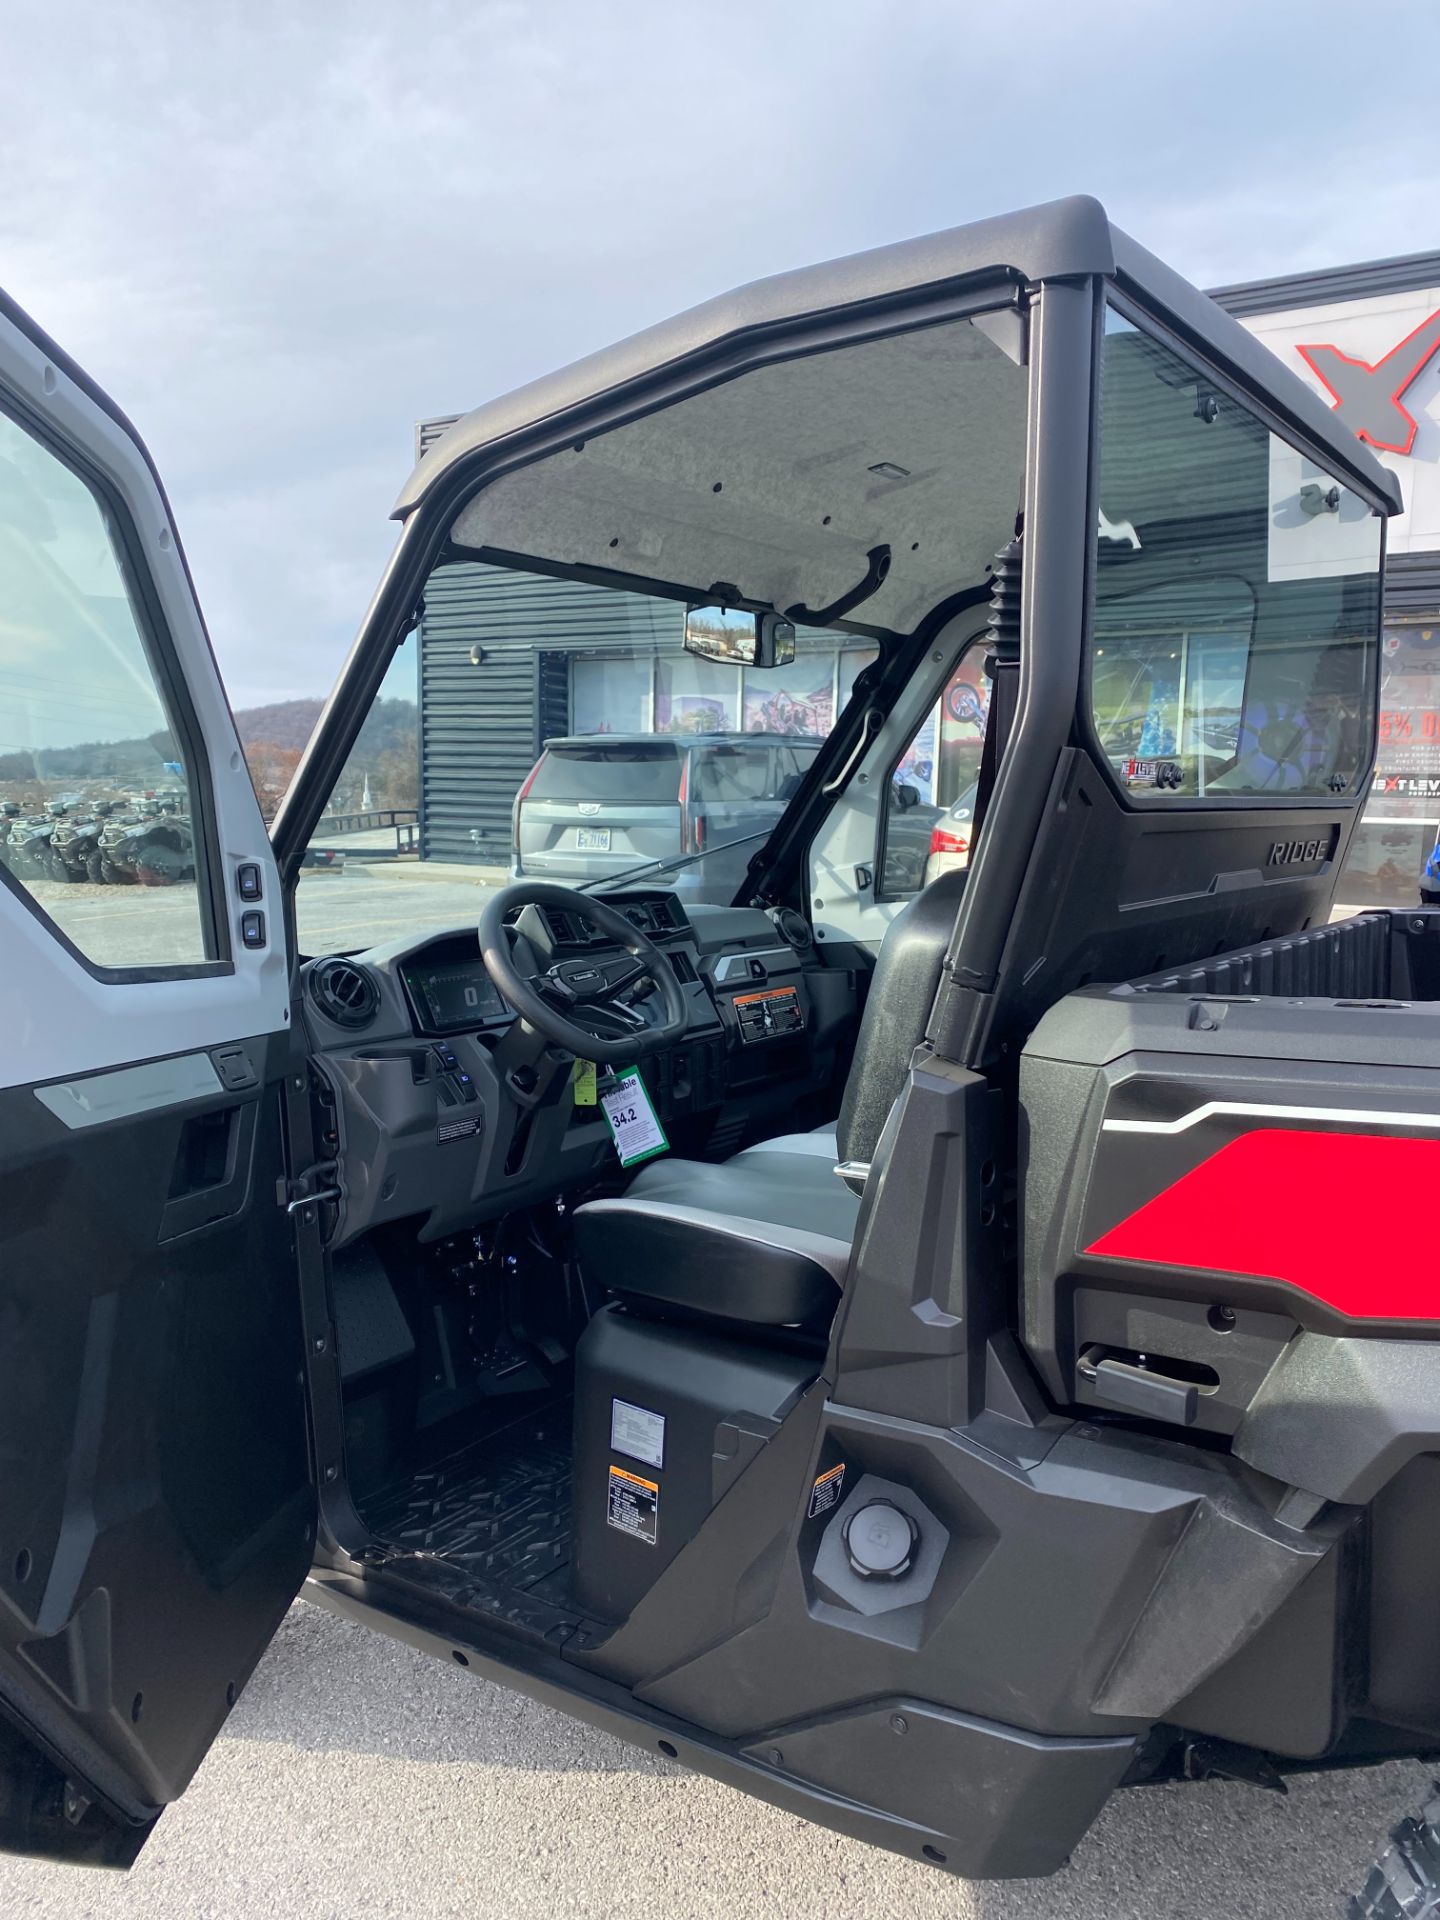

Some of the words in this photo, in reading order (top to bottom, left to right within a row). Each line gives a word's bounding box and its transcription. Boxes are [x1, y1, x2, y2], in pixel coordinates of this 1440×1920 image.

[1268, 839, 1328, 865] RIDGE
[464, 987, 478, 1007] 0
[612, 1108, 637, 1128] 34.2
